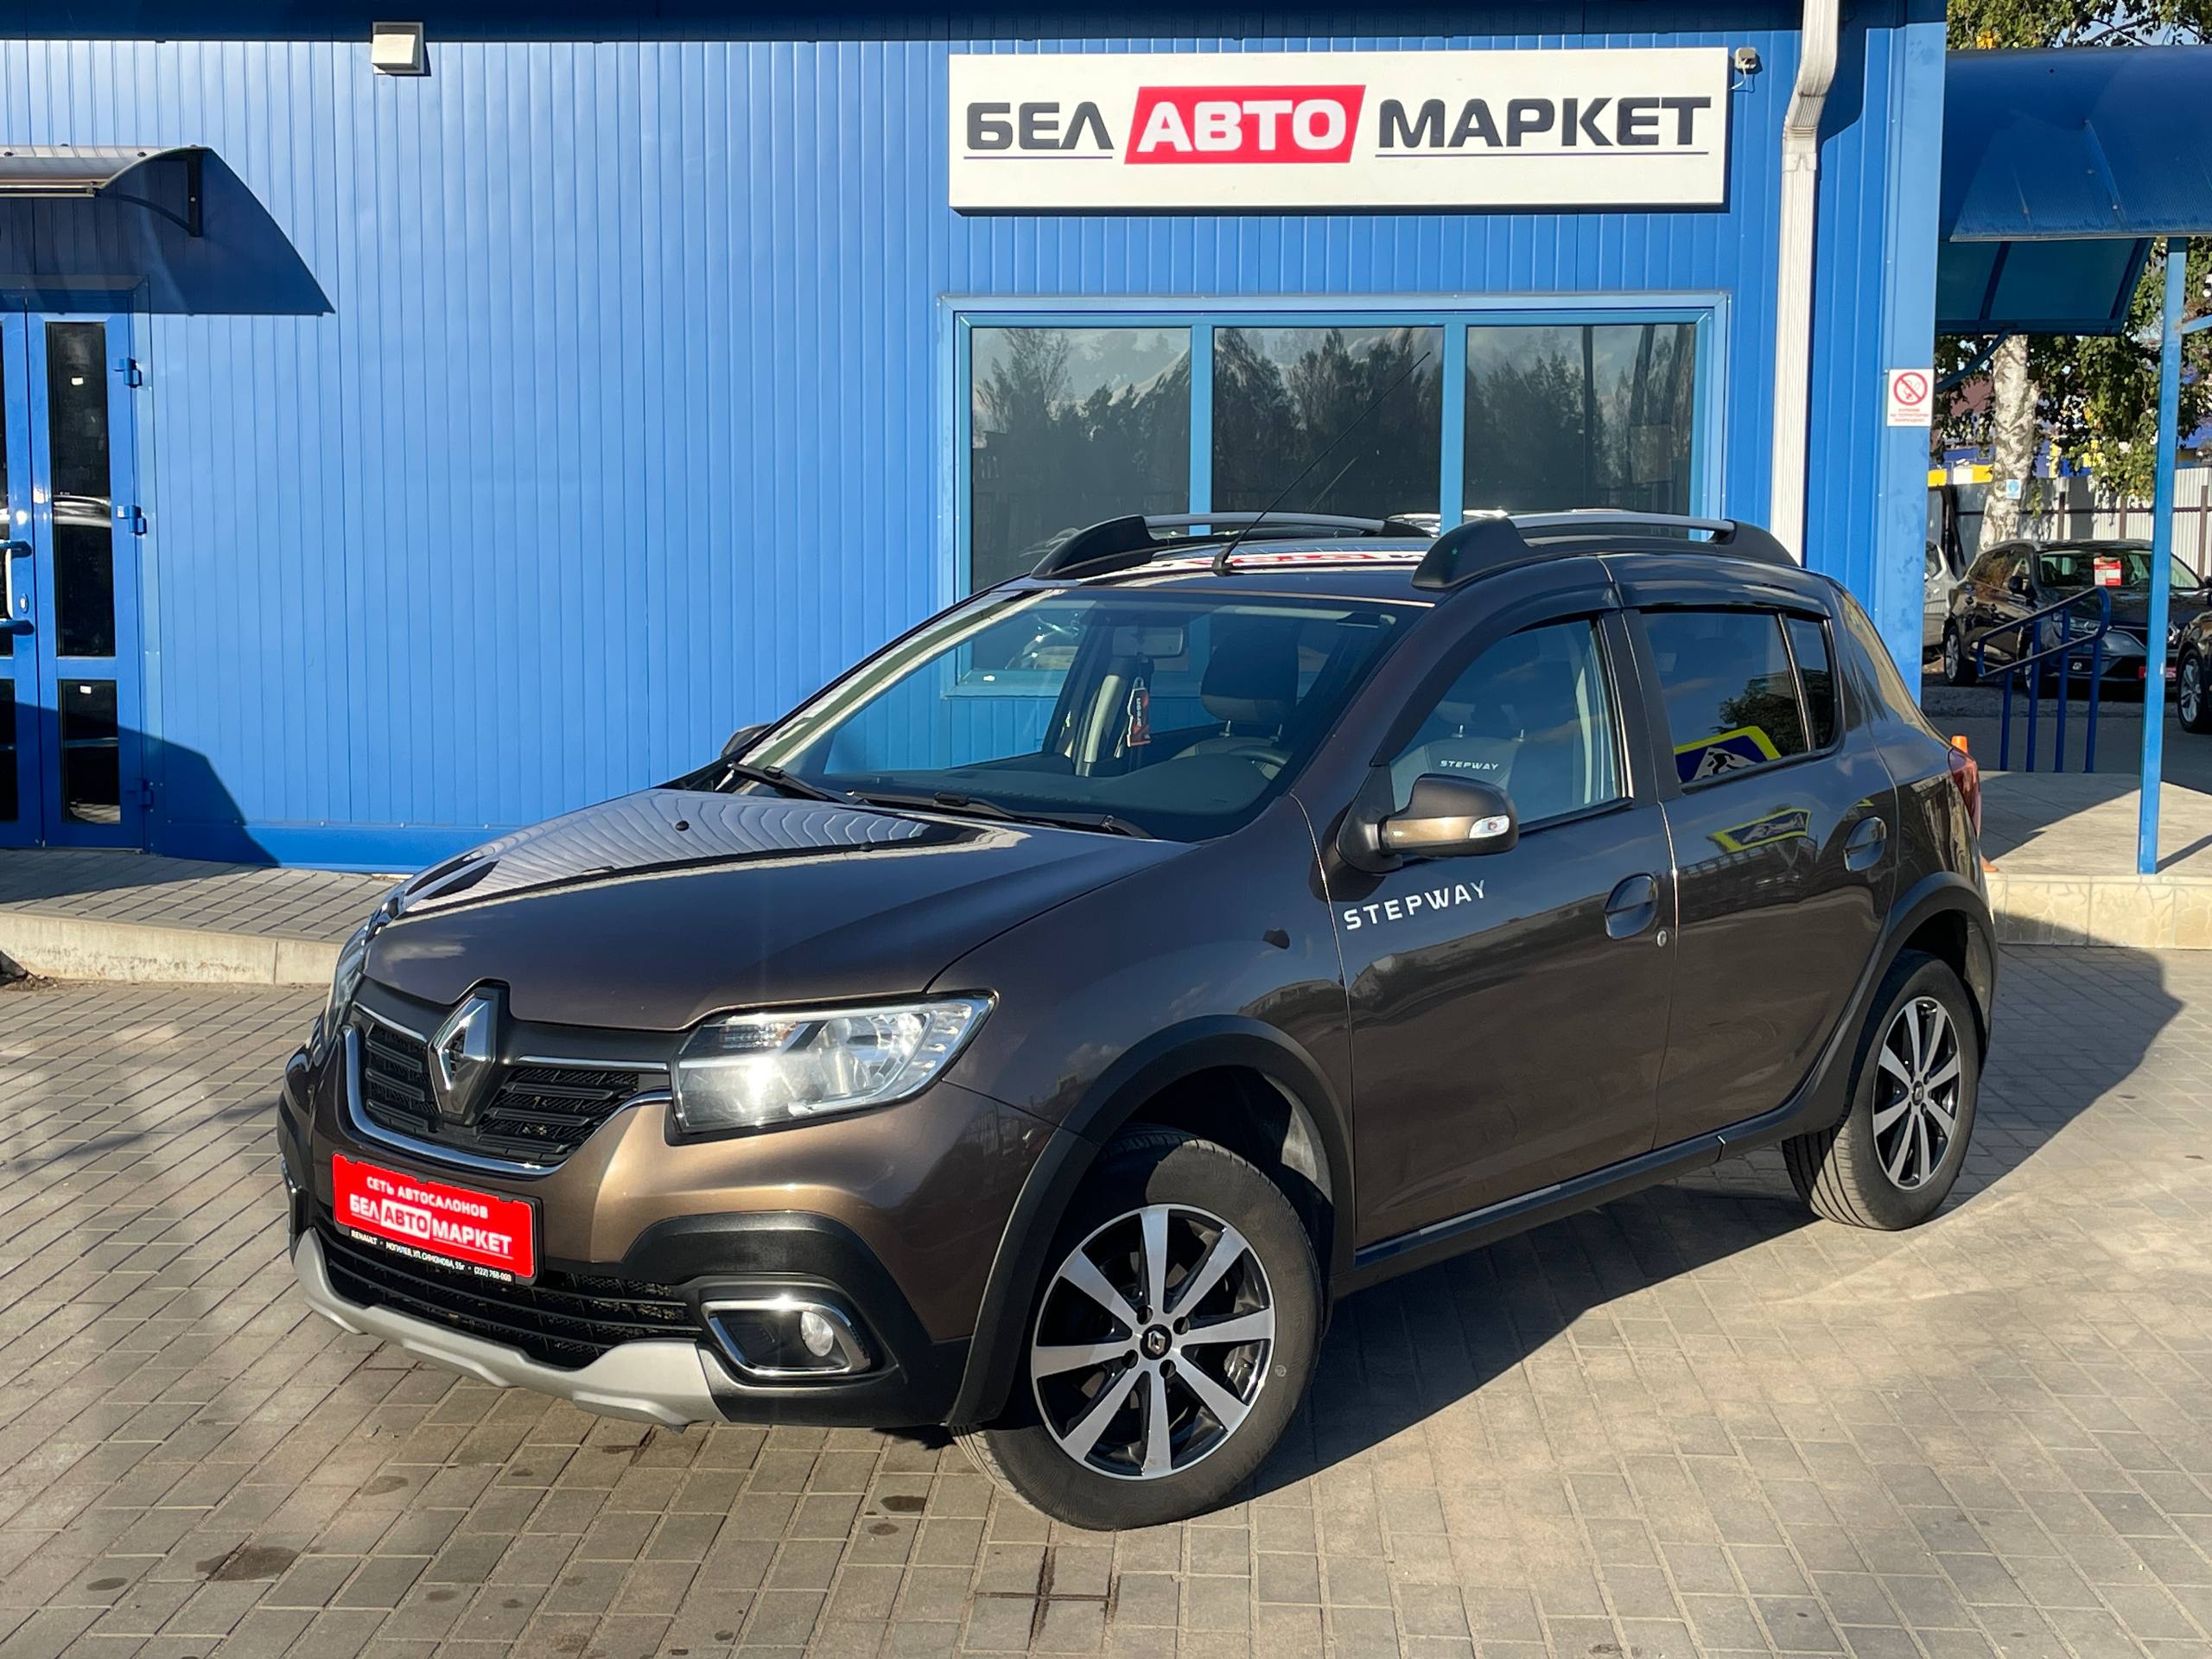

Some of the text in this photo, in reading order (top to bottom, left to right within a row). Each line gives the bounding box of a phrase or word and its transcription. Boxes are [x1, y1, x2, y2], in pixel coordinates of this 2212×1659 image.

[966, 96, 1712, 153] БЕЛ АВТО МАРКЕТ
[1440, 760, 1499, 771] STEPWAY
[1343, 880, 1485, 931] STEPWAY
[366, 1176, 488, 1219] СЕТЬ АВТОСАЛОНОВ
[349, 1194, 512, 1255] БЕЛ АВТО МАРКЕТ
[351, 1230, 378, 1245] RENAULT
